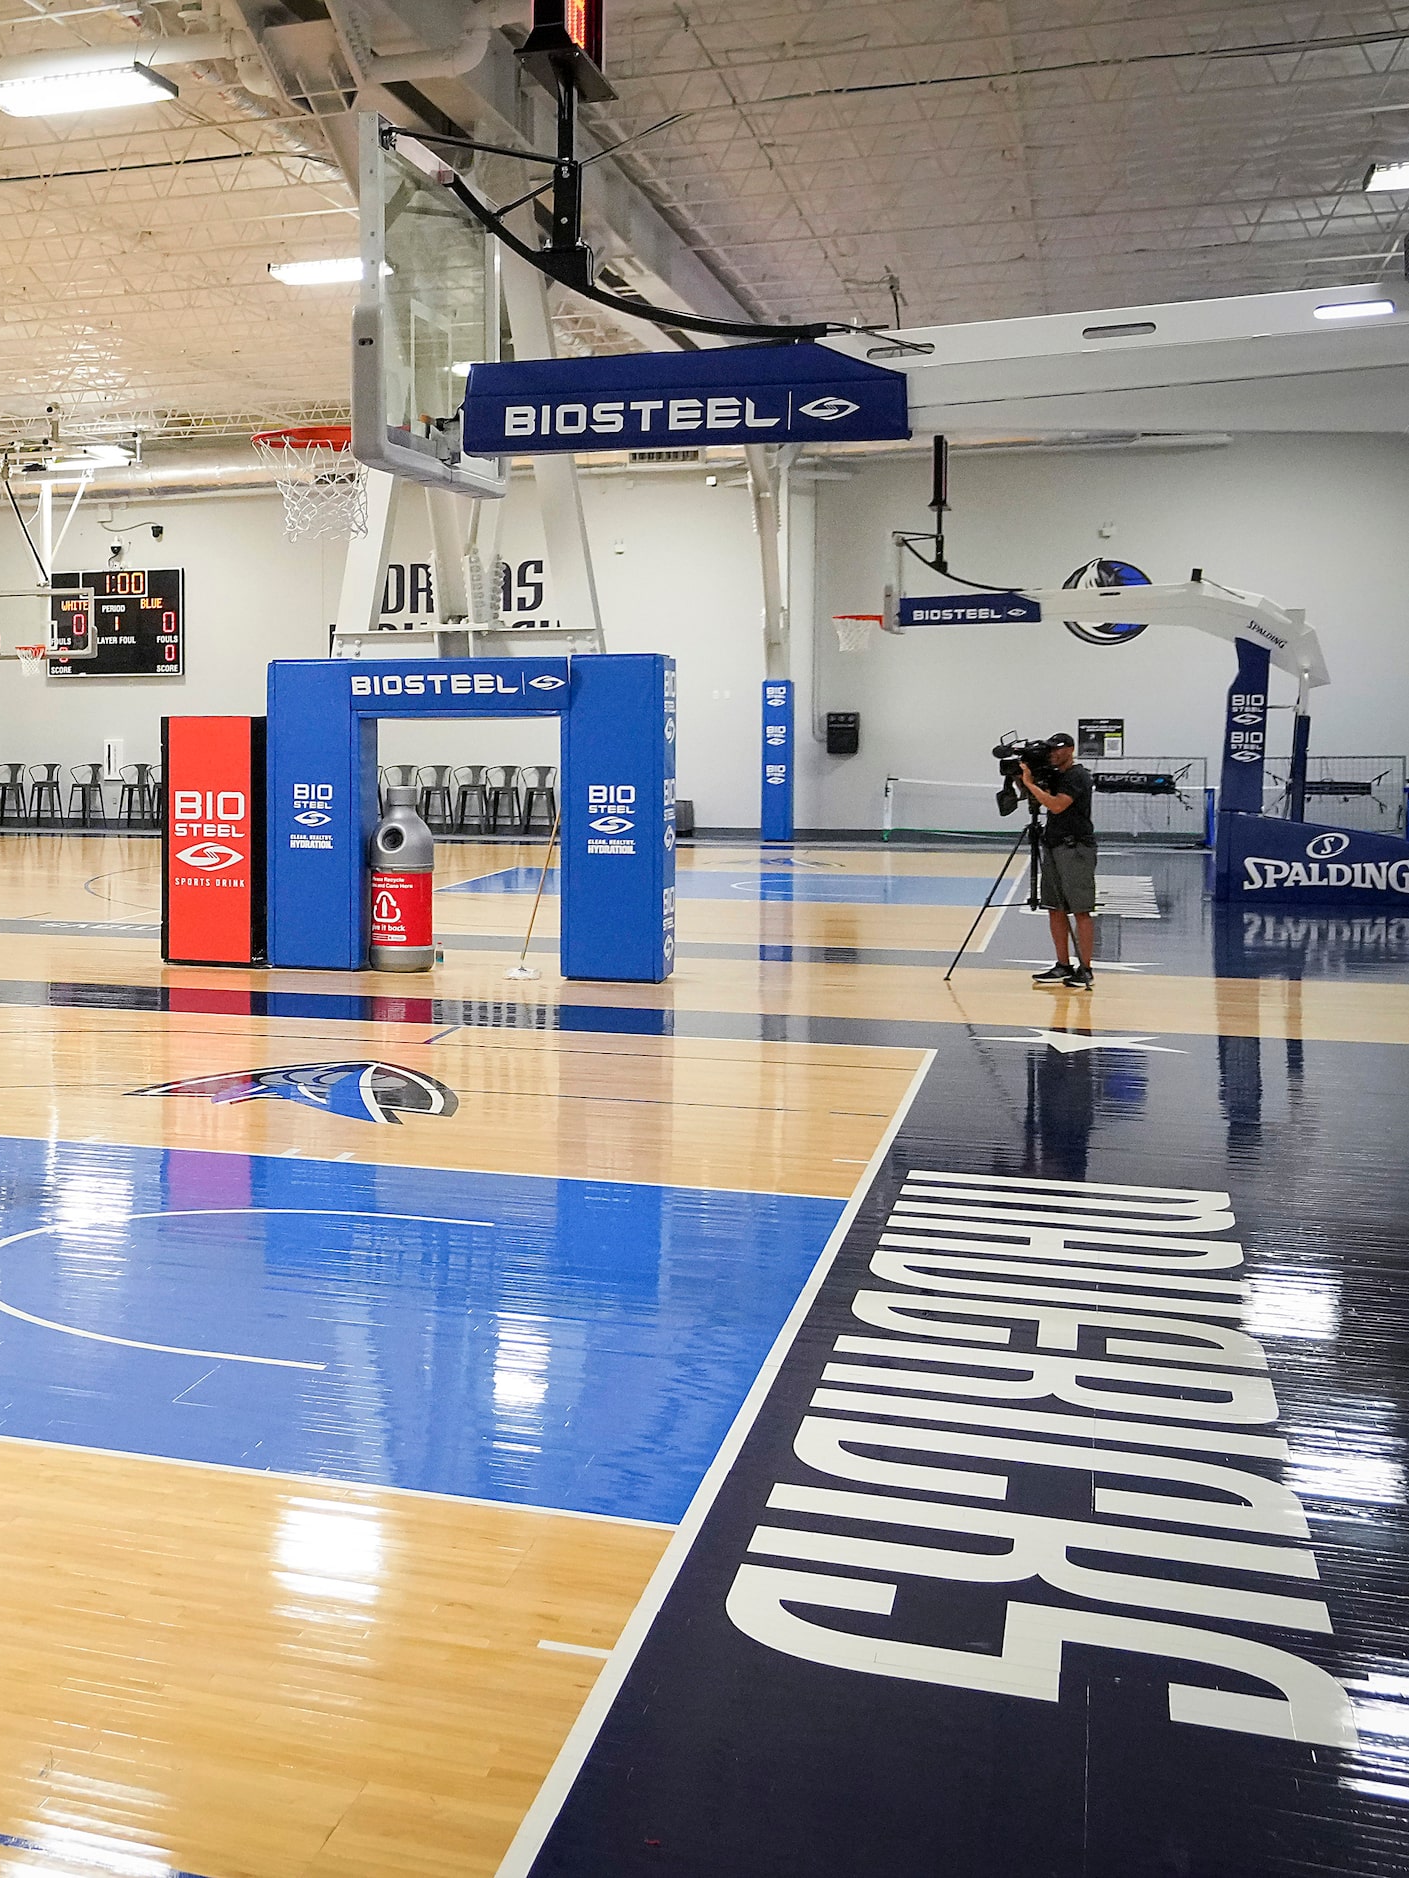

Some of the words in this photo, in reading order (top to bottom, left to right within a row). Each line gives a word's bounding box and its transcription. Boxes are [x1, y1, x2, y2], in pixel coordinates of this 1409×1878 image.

[504, 396, 781, 437] BIOSTEEL
[105, 572, 144, 594] 1:00
[61, 601, 89, 612] WHITE
[101, 604, 126, 613] PERIOD
[140, 598, 164, 609] BLUE
[912, 608, 1003, 621] BIOSTEEL
[73, 613, 86, 635] 0
[162, 611, 176, 633] 0
[97, 635, 118, 645] LAYER
[119, 635, 137, 645] FOUL
[156, 635, 179, 644] FOULS
[1246, 619, 1289, 650] SPALDING
[164, 644, 175, 661] 0
[51, 666, 73, 674] SCORE
[156, 664, 179, 673] SCORE
[351, 673, 520, 696] BIOSTEEL
[1231, 694, 1265, 707] BIO
[1230, 731, 1264, 744] BIO
[293, 783, 333, 801] BIO
[588, 785, 636, 803] BIO
[174, 791, 245, 821] BIO
[293, 800, 333, 810] STEEL
[588, 804, 636, 814] STEEL
[174, 823, 246, 838] STEEL
[1243, 856, 1409, 894] SPALDING
[174, 877, 211, 886] SPORTS
[215, 879, 245, 888] DRINK
[725, 1169, 1361, 1751] MAVERICKS
